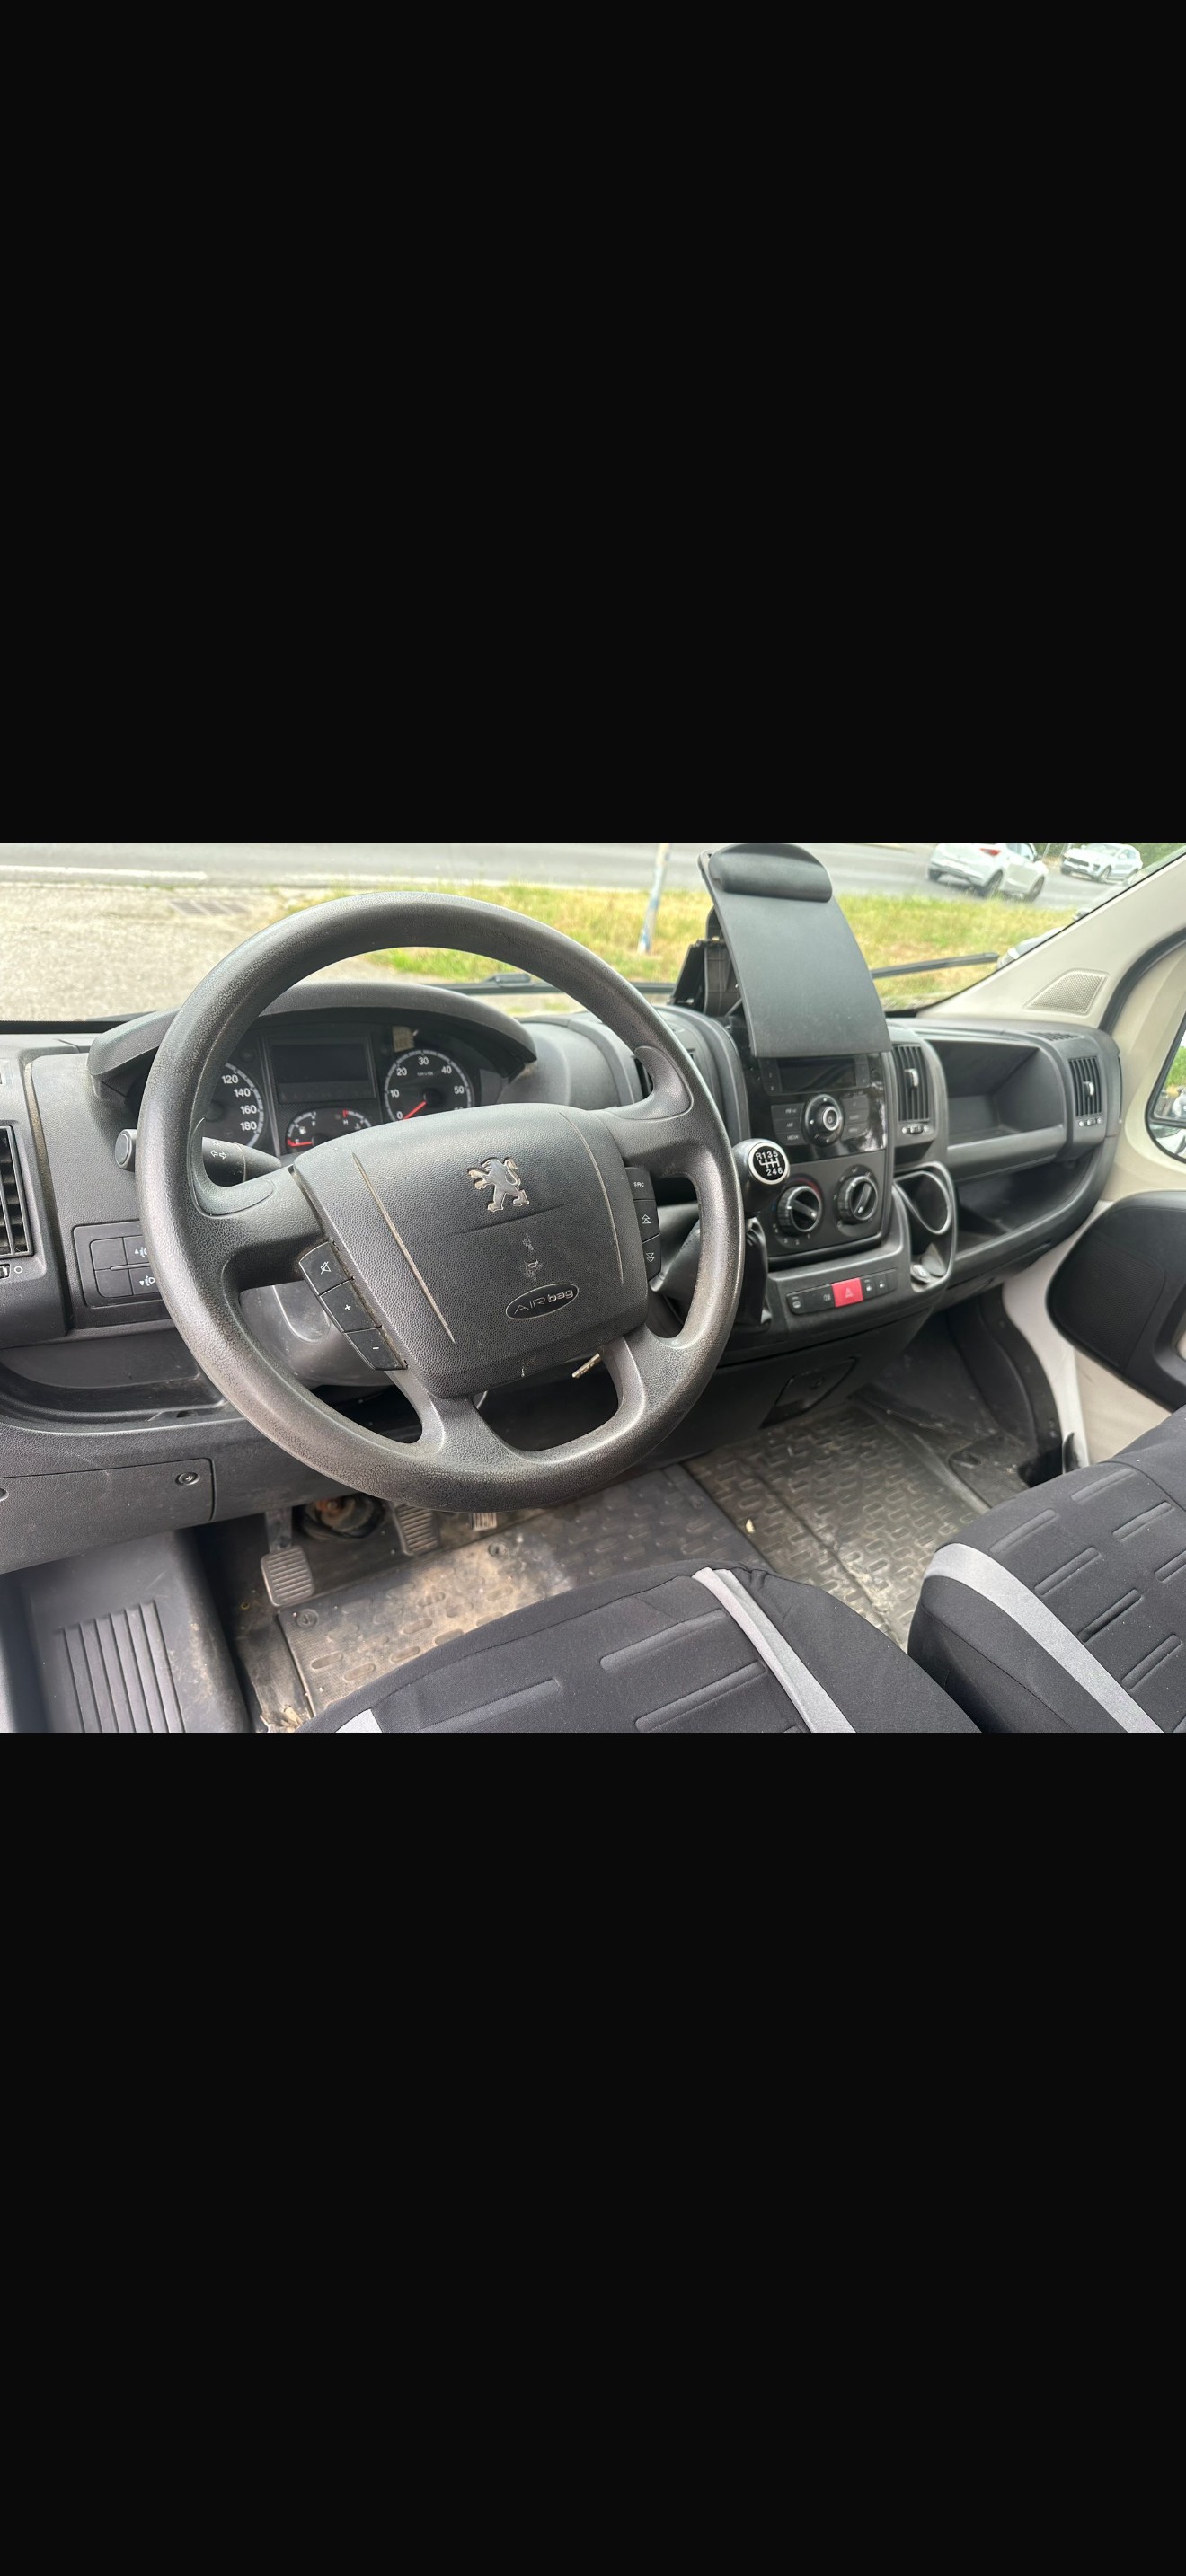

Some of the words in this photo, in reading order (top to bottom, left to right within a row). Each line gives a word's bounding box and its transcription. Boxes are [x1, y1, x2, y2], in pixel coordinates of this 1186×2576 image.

[418, 1056, 429, 1066] 30
[396, 1067, 408, 1076] 20
[441, 1065, 453, 1074] 40
[221, 1074, 239, 1084] 120
[234, 1087, 251, 1098] 140
[390, 1089, 400, 1098] 10
[453, 1085, 465, 1095] 50
[240, 1104, 257, 1115] 160
[396, 1110, 403, 1120] 0
[240, 1120, 257, 1131] 180
